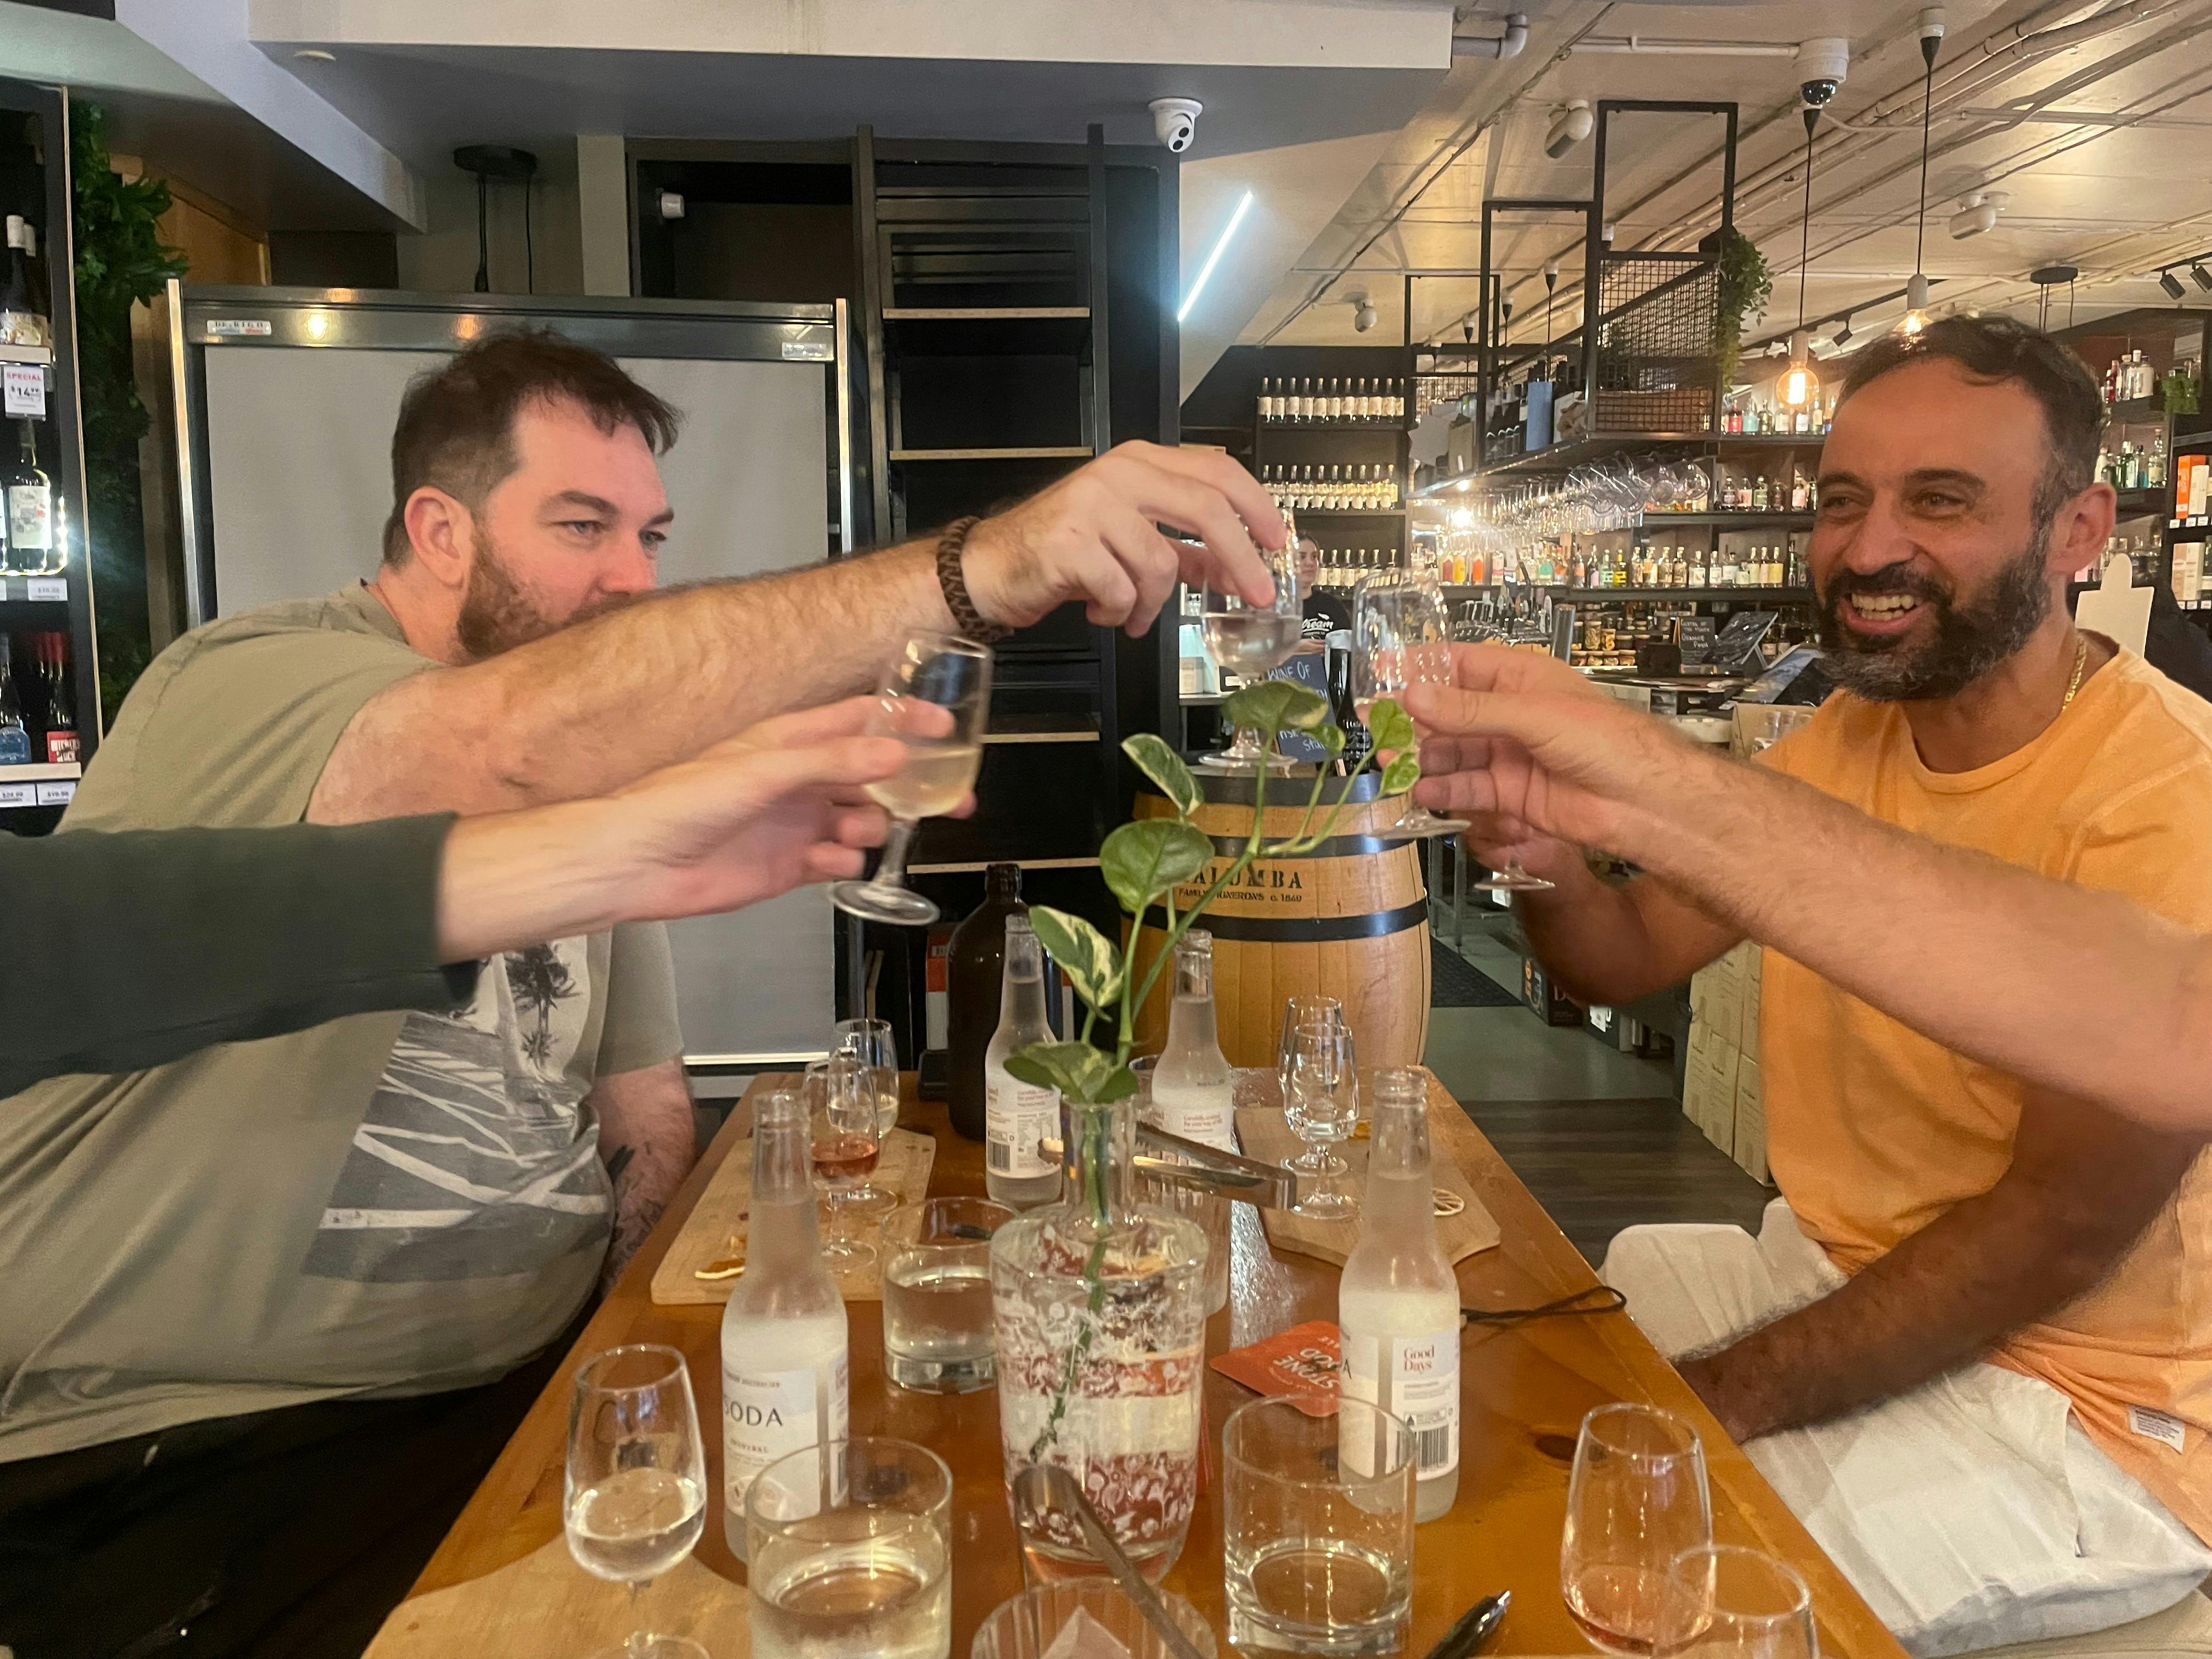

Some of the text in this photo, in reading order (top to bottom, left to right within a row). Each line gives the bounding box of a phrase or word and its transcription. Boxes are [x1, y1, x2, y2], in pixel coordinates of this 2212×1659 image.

[1267, 661, 1311, 681] WINE OF
[1185, 866, 1302, 889] ALUMBA
[1404, 1344, 1435, 1359] Good
[1404, 1360, 1432, 1375] Days
